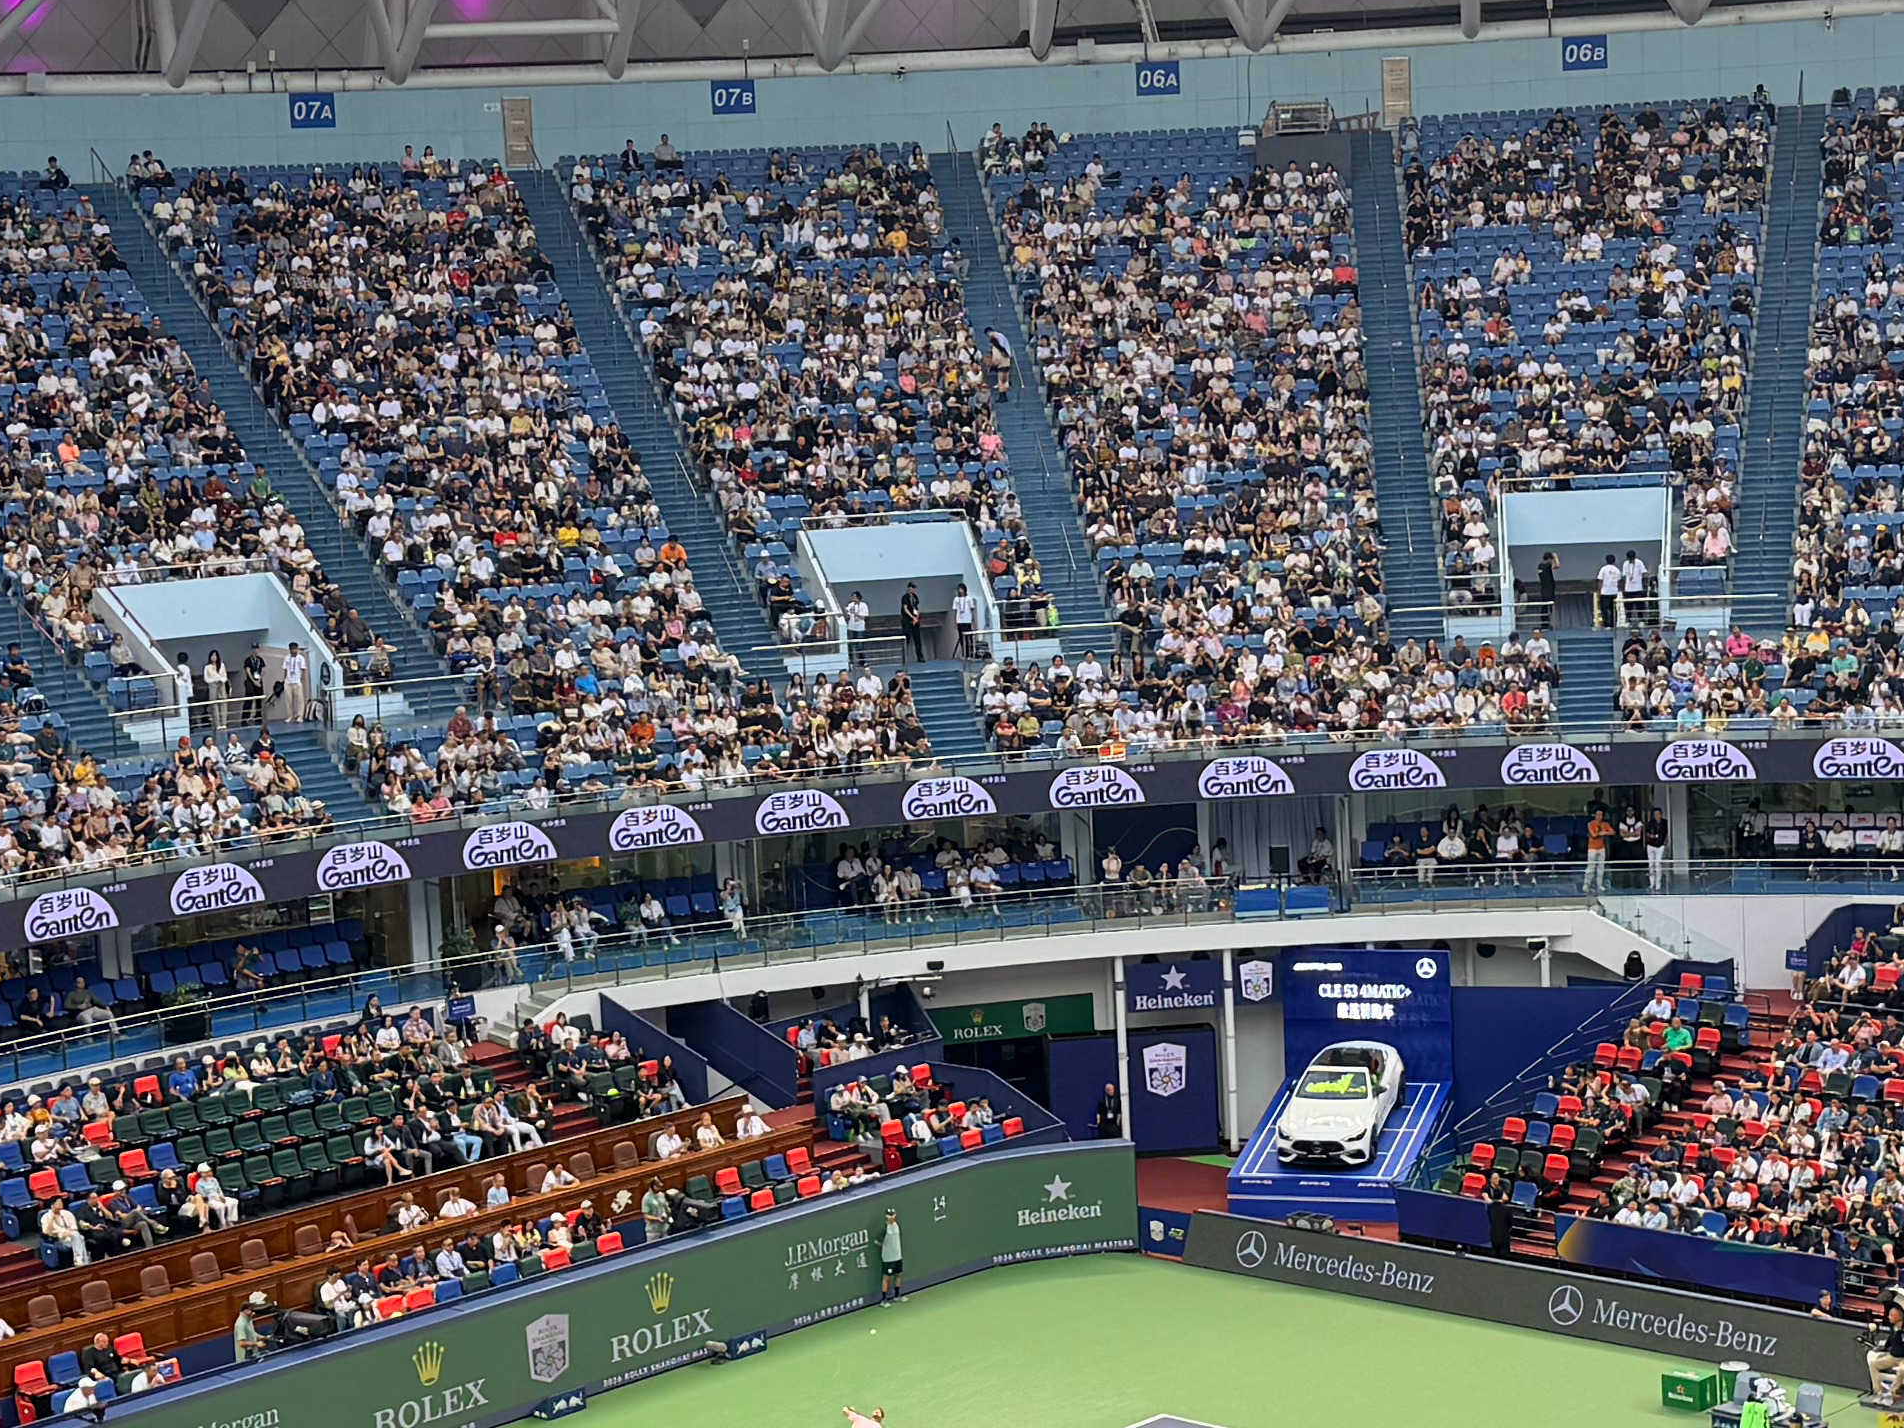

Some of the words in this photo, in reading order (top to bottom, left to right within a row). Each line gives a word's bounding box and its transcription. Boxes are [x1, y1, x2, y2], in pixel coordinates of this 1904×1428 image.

[1565, 43, 1605, 62] 06B
[1139, 69, 1177, 88] 06A
[714, 88, 753, 106] 07B
[293, 104, 333, 123] 07A
[1518, 747, 1571, 762] 百岁山
[1673, 743, 1727, 758] 百岁山
[1831, 741, 1886, 756] 百岁山
[1215, 760, 1266, 775] 百岁山
[1366, 752, 1418, 768] 百岁山
[1066, 769, 1117, 785] 百岁山
[918, 781, 969, 797] 百岁山
[771, 793, 821, 811] 百岁山
[625, 808, 675, 827] 百岁山
[478, 825, 529, 844] 百岁山
[332, 845, 382, 865] 百岁山
[186, 867, 236, 888] 百岁山
[39, 892, 90, 914] 百岁山
[1343, 983, 1359, 998] 53
[1135, 993, 1215, 1011] Heineken
[954, 1024, 1002, 1040] ROLEX
[1017, 1204, 1103, 1227] Heineken
[1045, 1243, 1091, 1255] SHANGHAI
[1093, 1239, 1134, 1250] MASTERS
[1273, 1242, 1435, 1294] Mercedes-Benz
[610, 1308, 714, 1363] ROLEX
[1591, 1298, 1778, 1358] Mercedes-Benz
